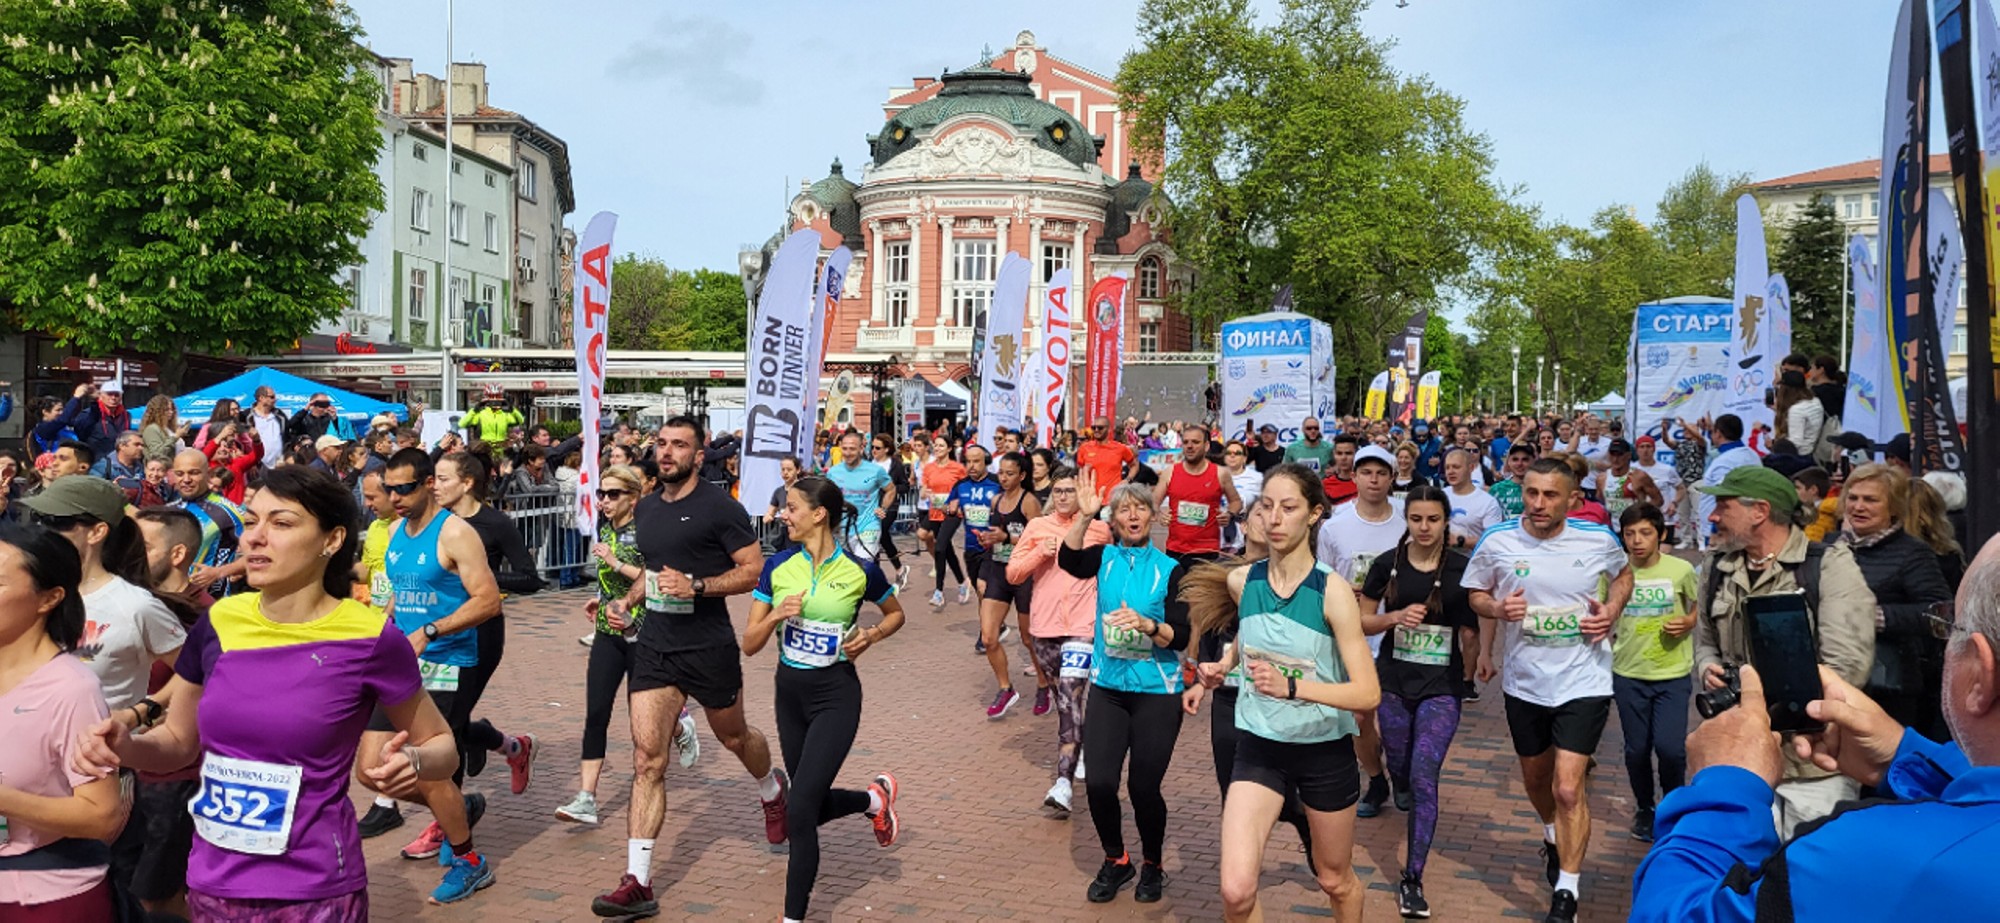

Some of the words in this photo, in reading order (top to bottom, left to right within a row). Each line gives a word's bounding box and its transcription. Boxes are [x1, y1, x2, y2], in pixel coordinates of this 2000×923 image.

[1652, 313, 1733, 333] СТАРТ
[1226, 329, 1304, 351] ФИНАЛ
[756, 315, 784, 397] BORN
[779, 323, 804, 400] WINNER
[970, 487, 984, 501] 14
[1533, 613, 1579, 632] 1663
[790, 630, 829, 655] 555
[1403, 629, 1445, 649] 1079
[1062, 652, 1088, 667] 547
[202, 784, 270, 828] 552
